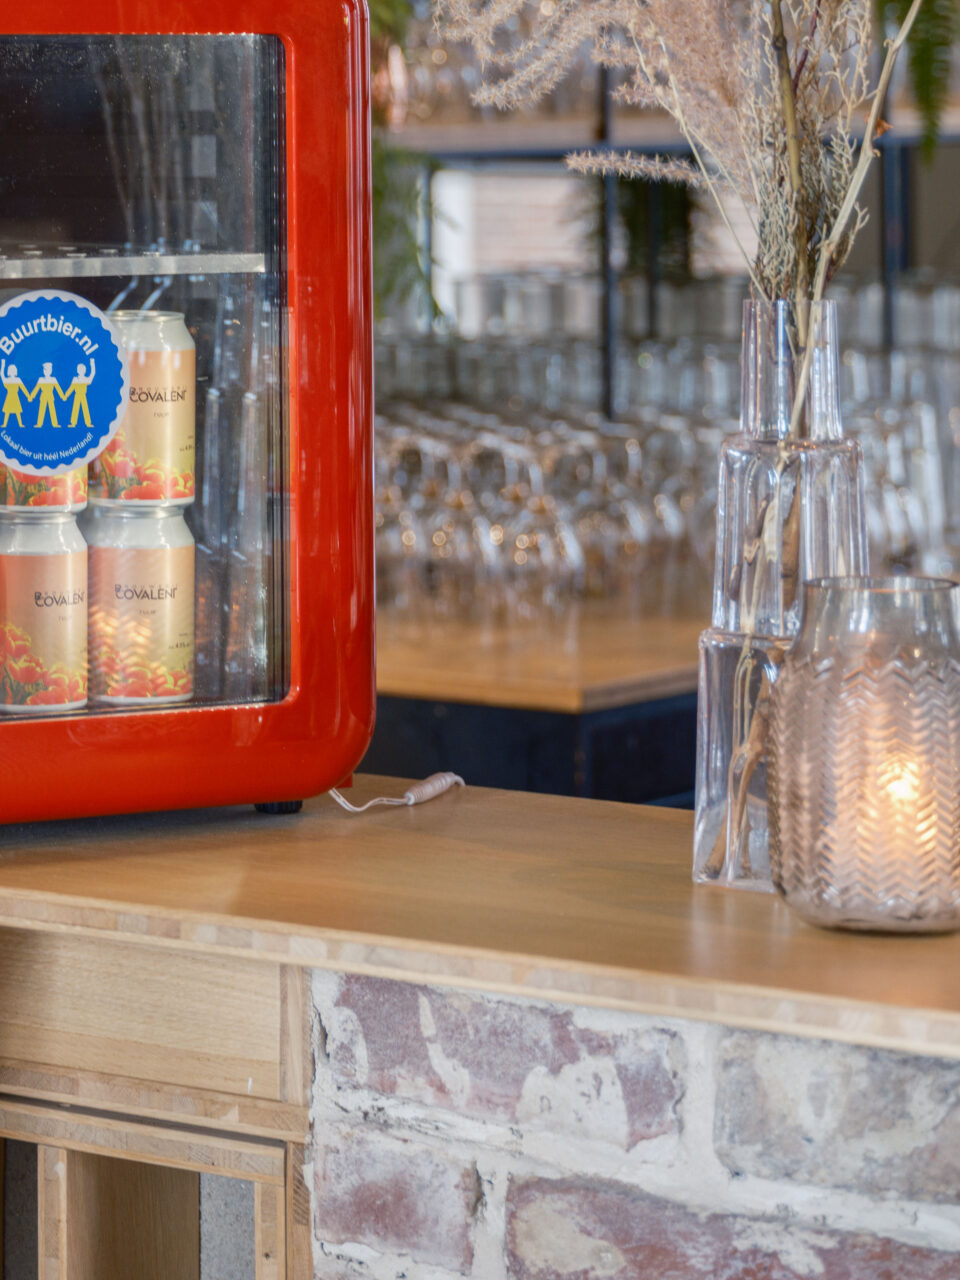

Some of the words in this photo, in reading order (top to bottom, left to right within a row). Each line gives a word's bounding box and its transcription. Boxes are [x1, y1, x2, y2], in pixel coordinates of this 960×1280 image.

[0, 430, 21, 452] Lokaal
[19, 447, 33, 458] bier
[33, 452, 42, 460] uit
[59, 432, 94, 459] Nederland!
[115, 588, 178, 600] COVALENT
